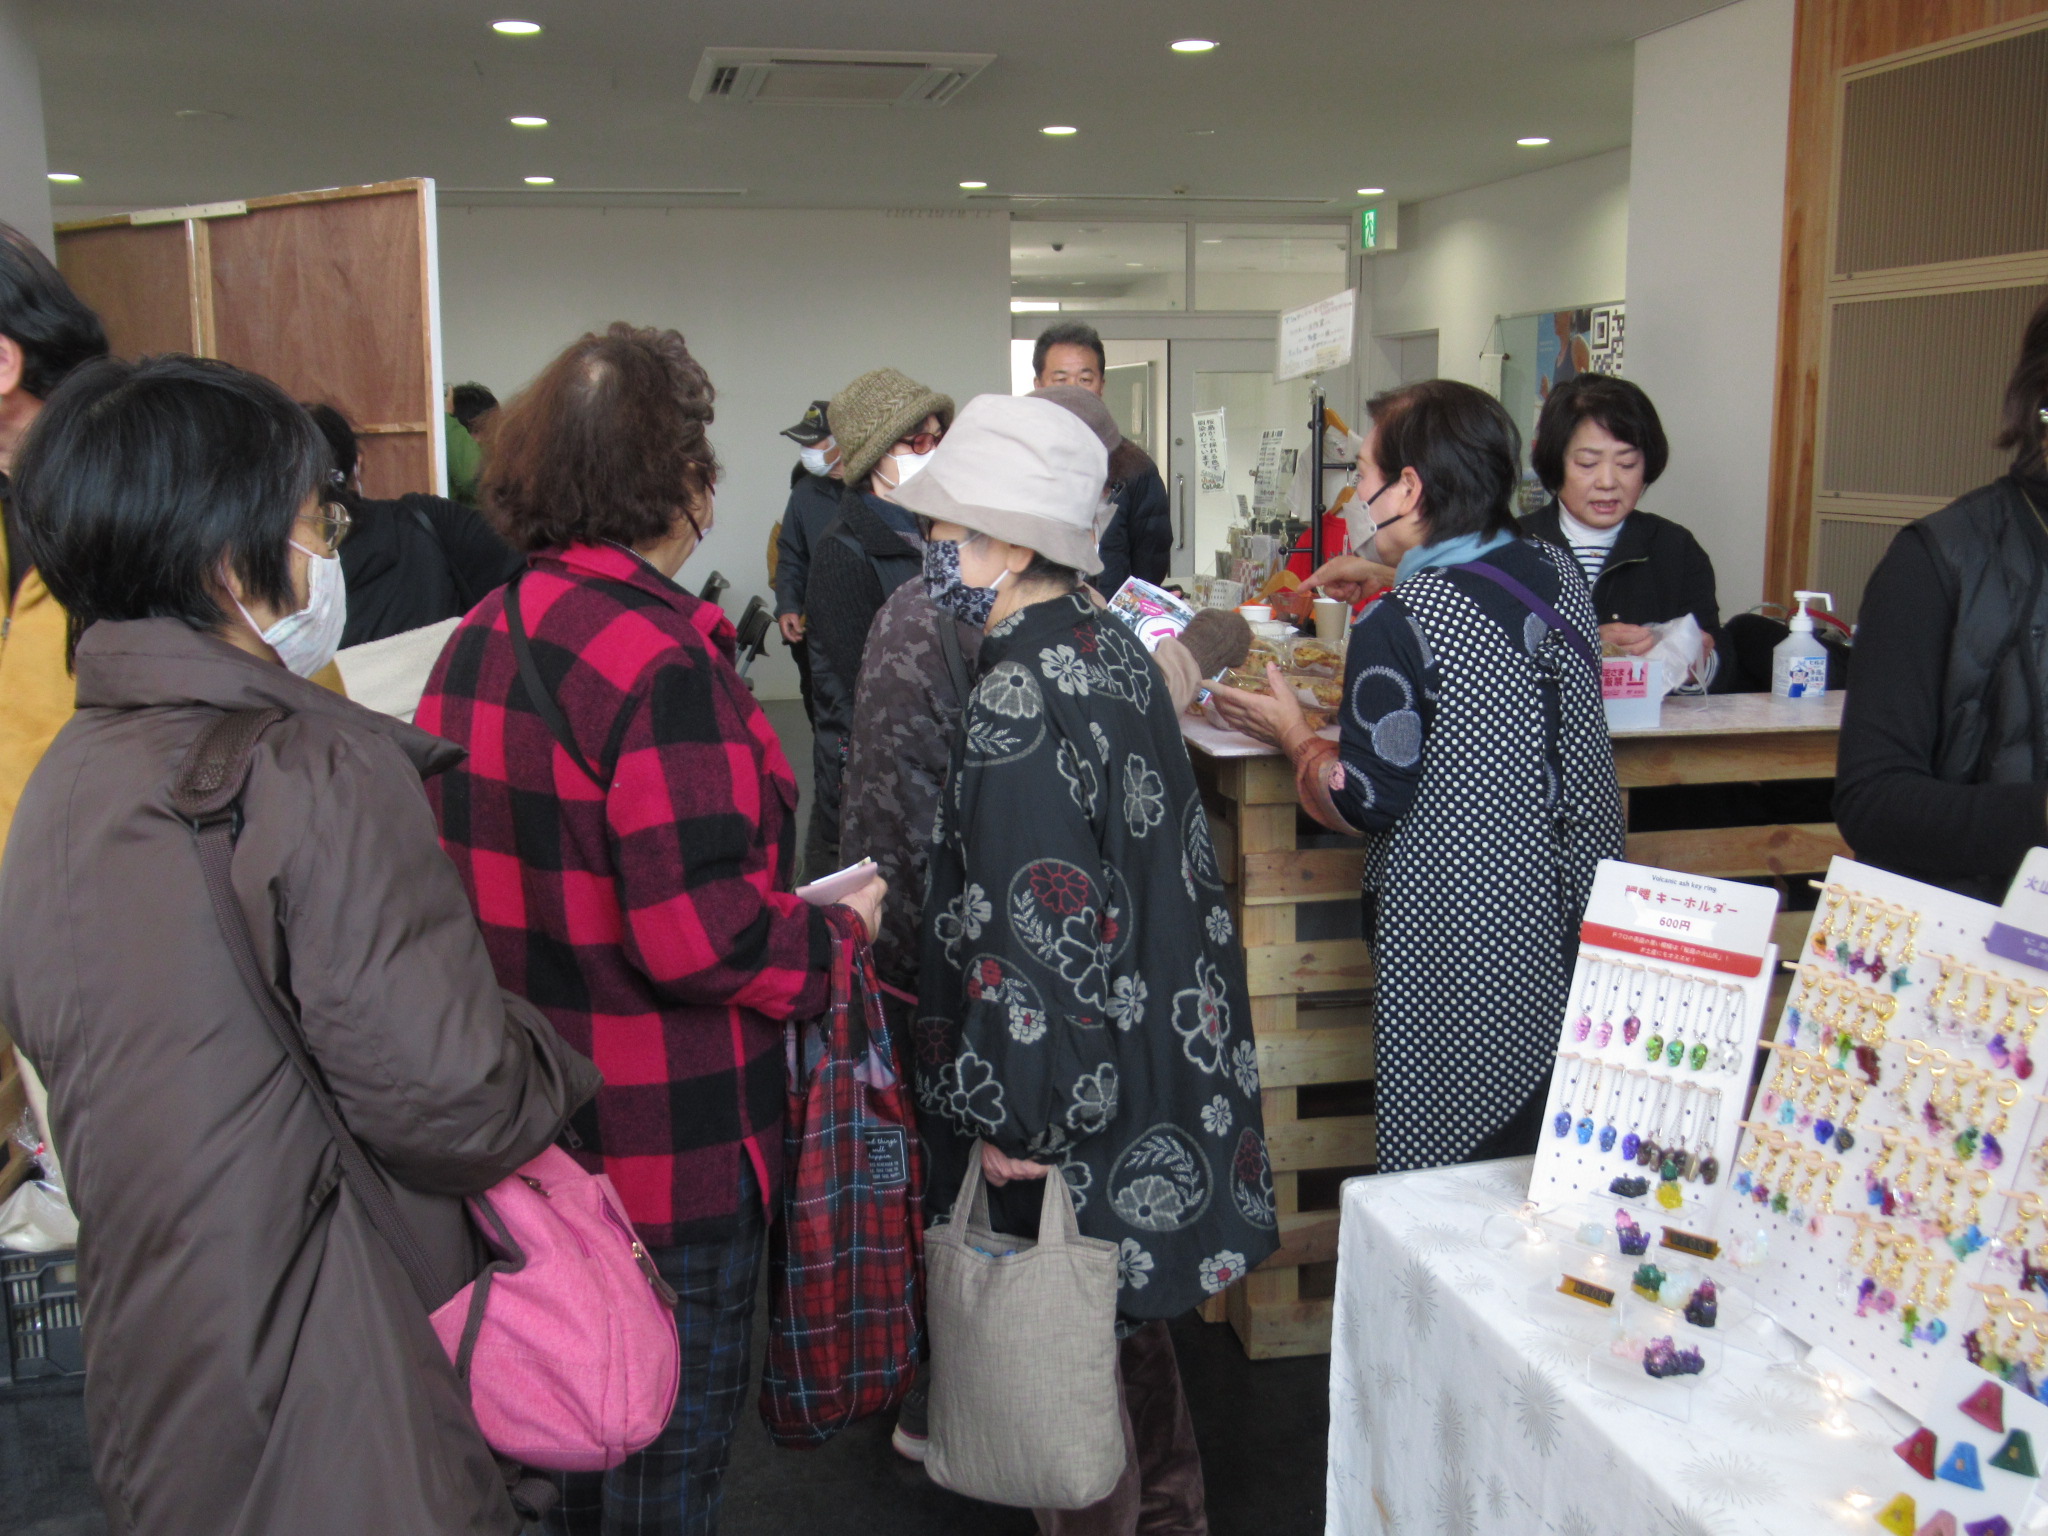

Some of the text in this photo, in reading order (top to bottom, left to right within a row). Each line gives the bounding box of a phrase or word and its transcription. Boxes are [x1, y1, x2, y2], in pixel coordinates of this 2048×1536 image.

[1652, 874, 1717, 894] Volcanic ash key ring
[1656, 891, 1738, 914] キーホルダー
[1659, 916, 1691, 931] 600円
[877, 1137, 898, 1147] things
